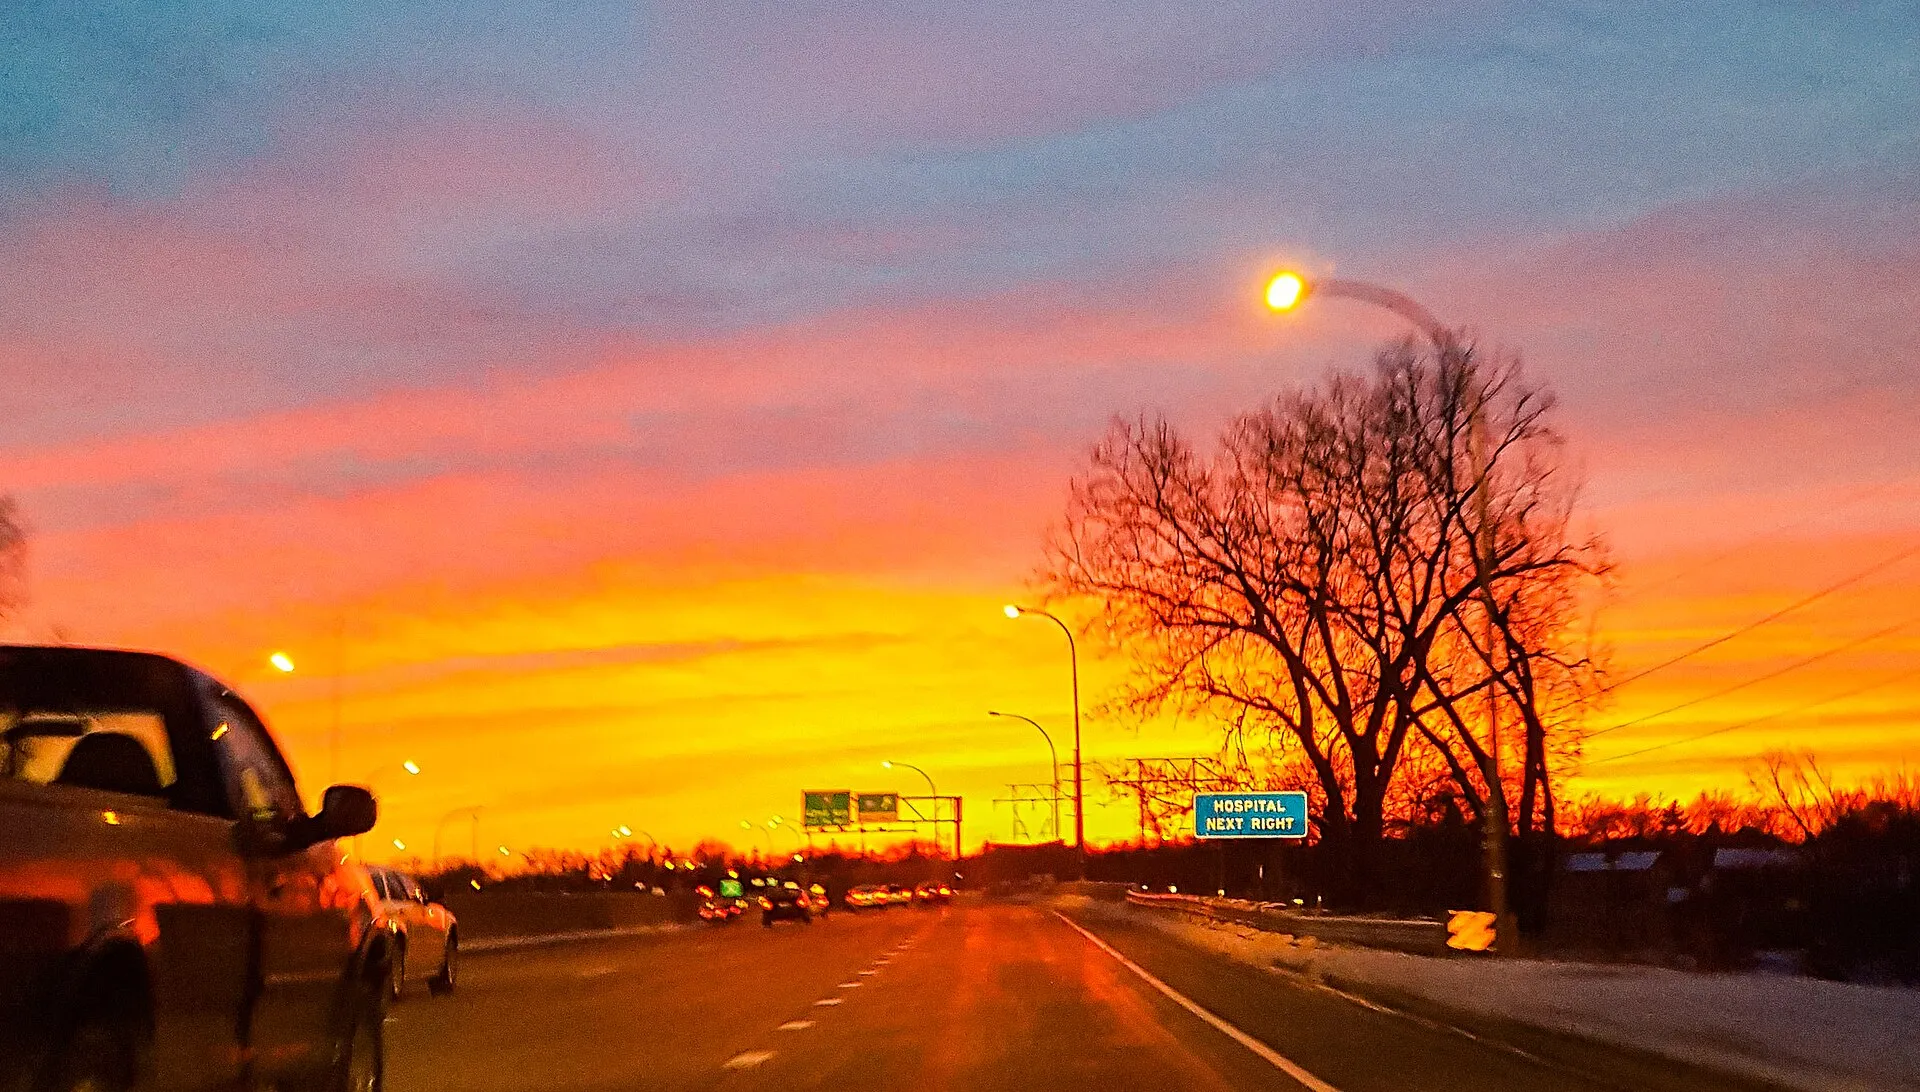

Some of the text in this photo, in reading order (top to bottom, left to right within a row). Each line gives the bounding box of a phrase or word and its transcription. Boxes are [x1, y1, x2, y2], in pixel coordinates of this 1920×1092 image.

[1213, 799, 1286, 813] HOSPITAL
[1206, 817, 1294, 830] NEXT RIGHT
